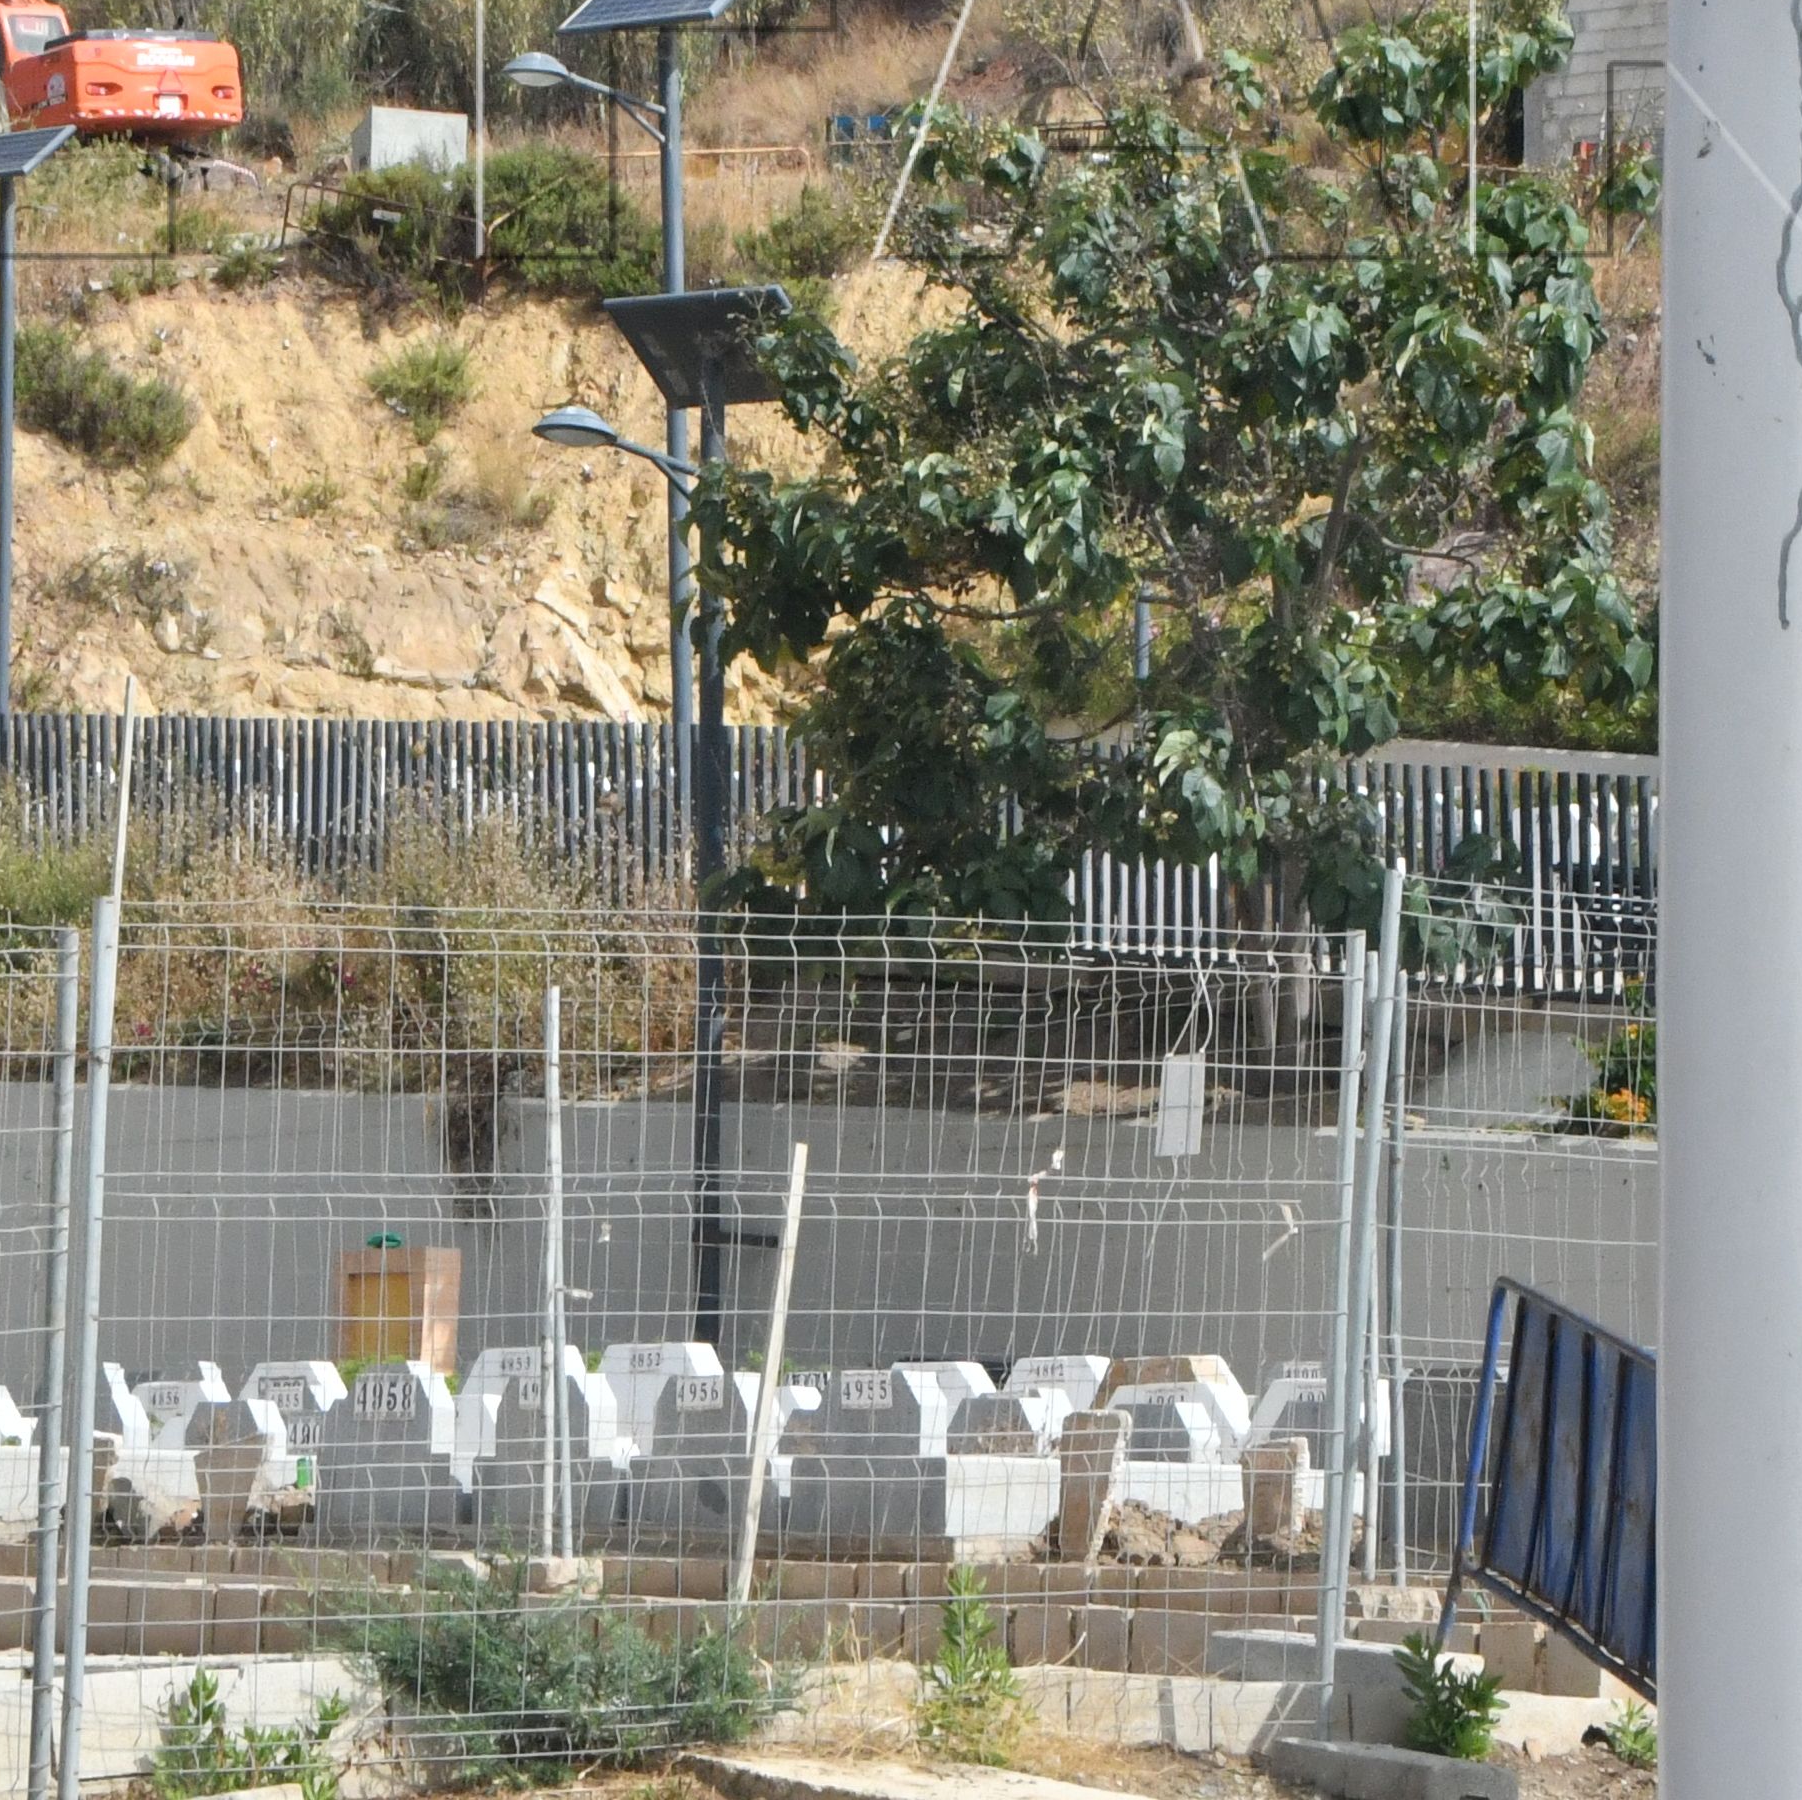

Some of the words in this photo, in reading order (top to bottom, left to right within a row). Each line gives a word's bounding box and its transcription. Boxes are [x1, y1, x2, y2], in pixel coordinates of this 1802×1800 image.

[356, 1381, 413, 1412] 4958
[677, 1379, 719, 1402] 4956
[842, 1379, 888, 1401] 4955
